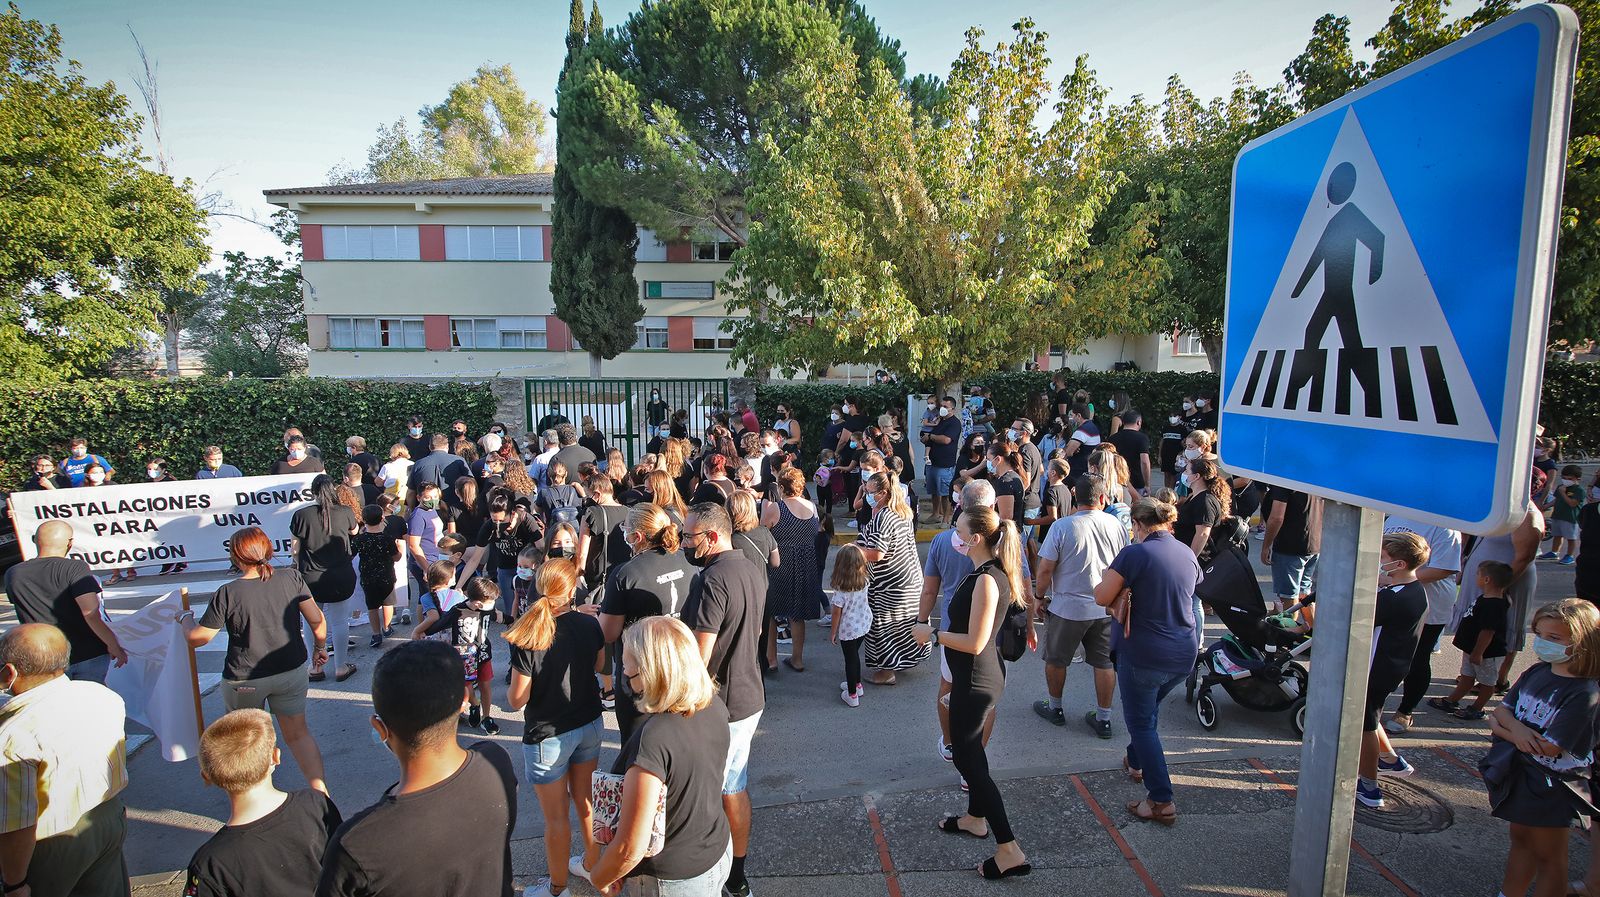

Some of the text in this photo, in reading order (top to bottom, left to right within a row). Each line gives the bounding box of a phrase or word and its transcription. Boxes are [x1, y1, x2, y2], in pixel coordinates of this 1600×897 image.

[34, 488, 314, 520] INSTALACIONES DIGNAS
[93, 513, 262, 537] PARA UNA
[69, 542, 186, 566] DUCACIÓN
